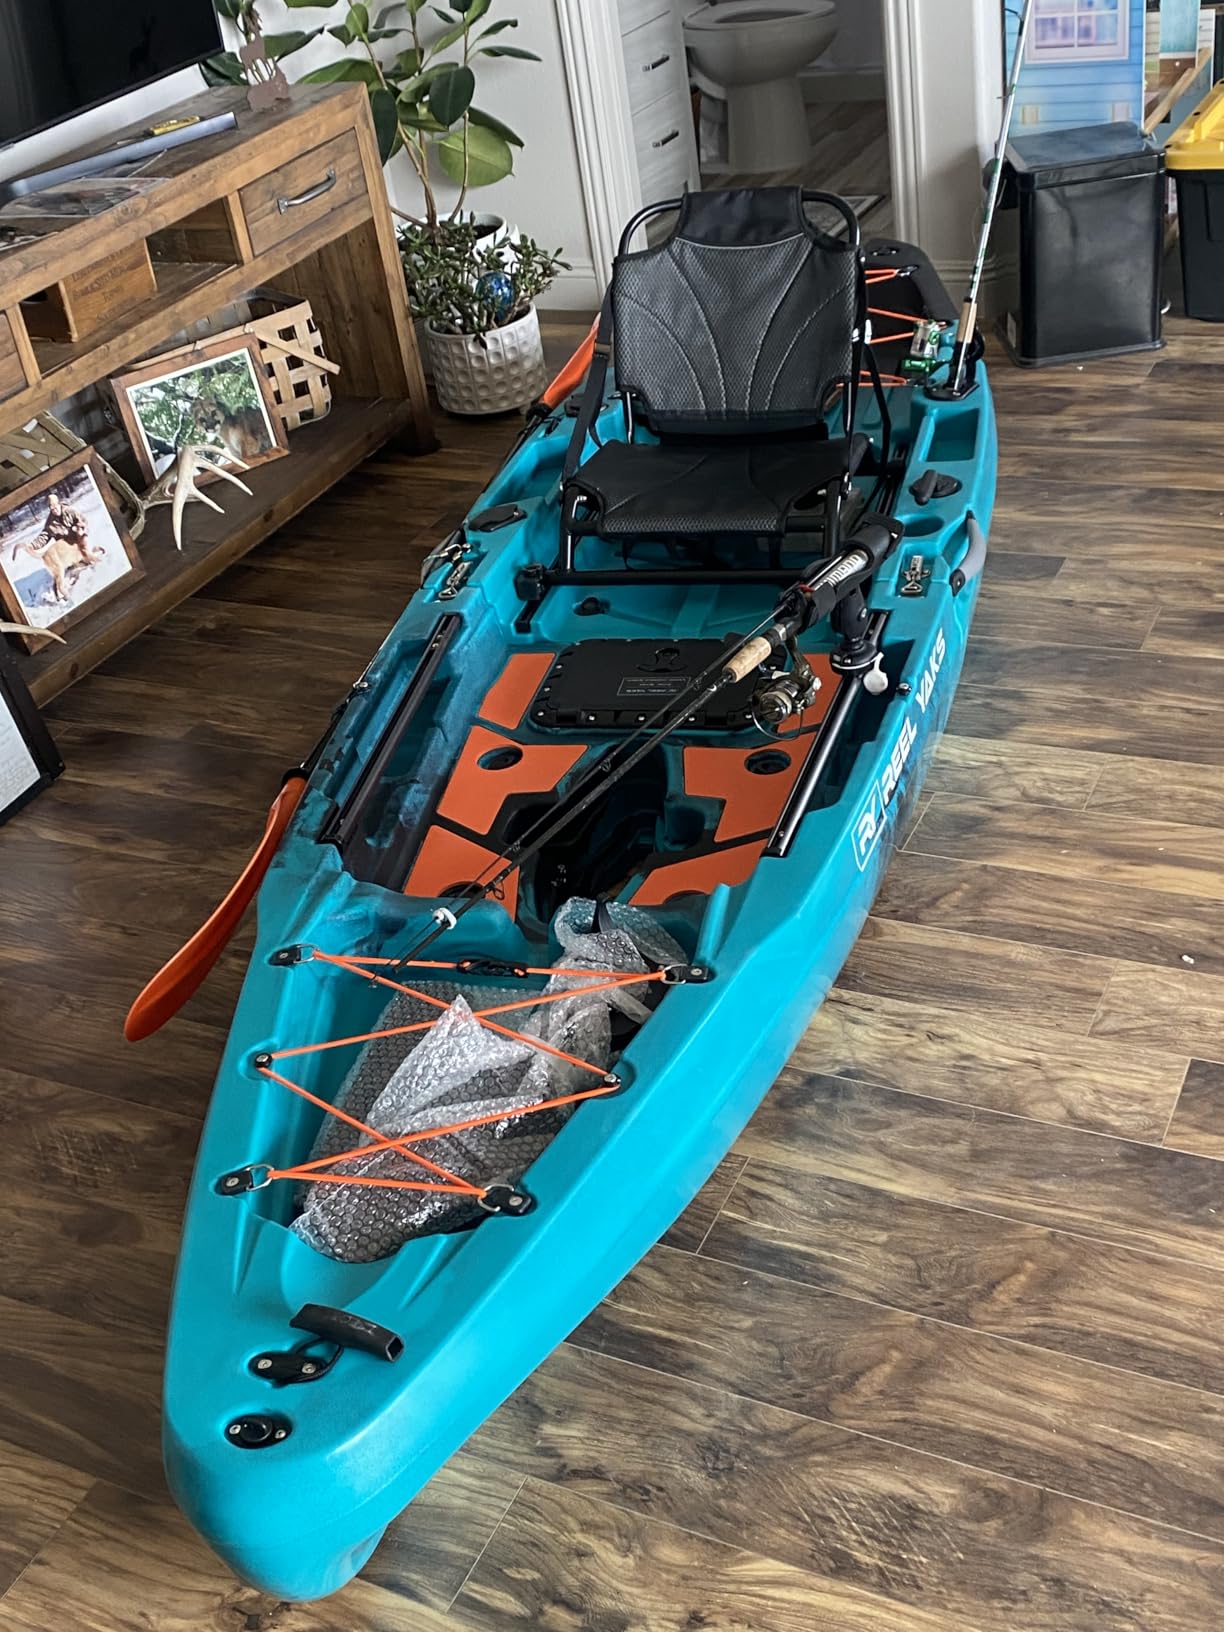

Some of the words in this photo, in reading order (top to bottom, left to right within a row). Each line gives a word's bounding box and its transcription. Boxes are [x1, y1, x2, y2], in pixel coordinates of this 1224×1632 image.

[815, 554, 864, 590] IMANO
[881, 716, 918, 805] REEL
[915, 627, 946, 713] YAKS
